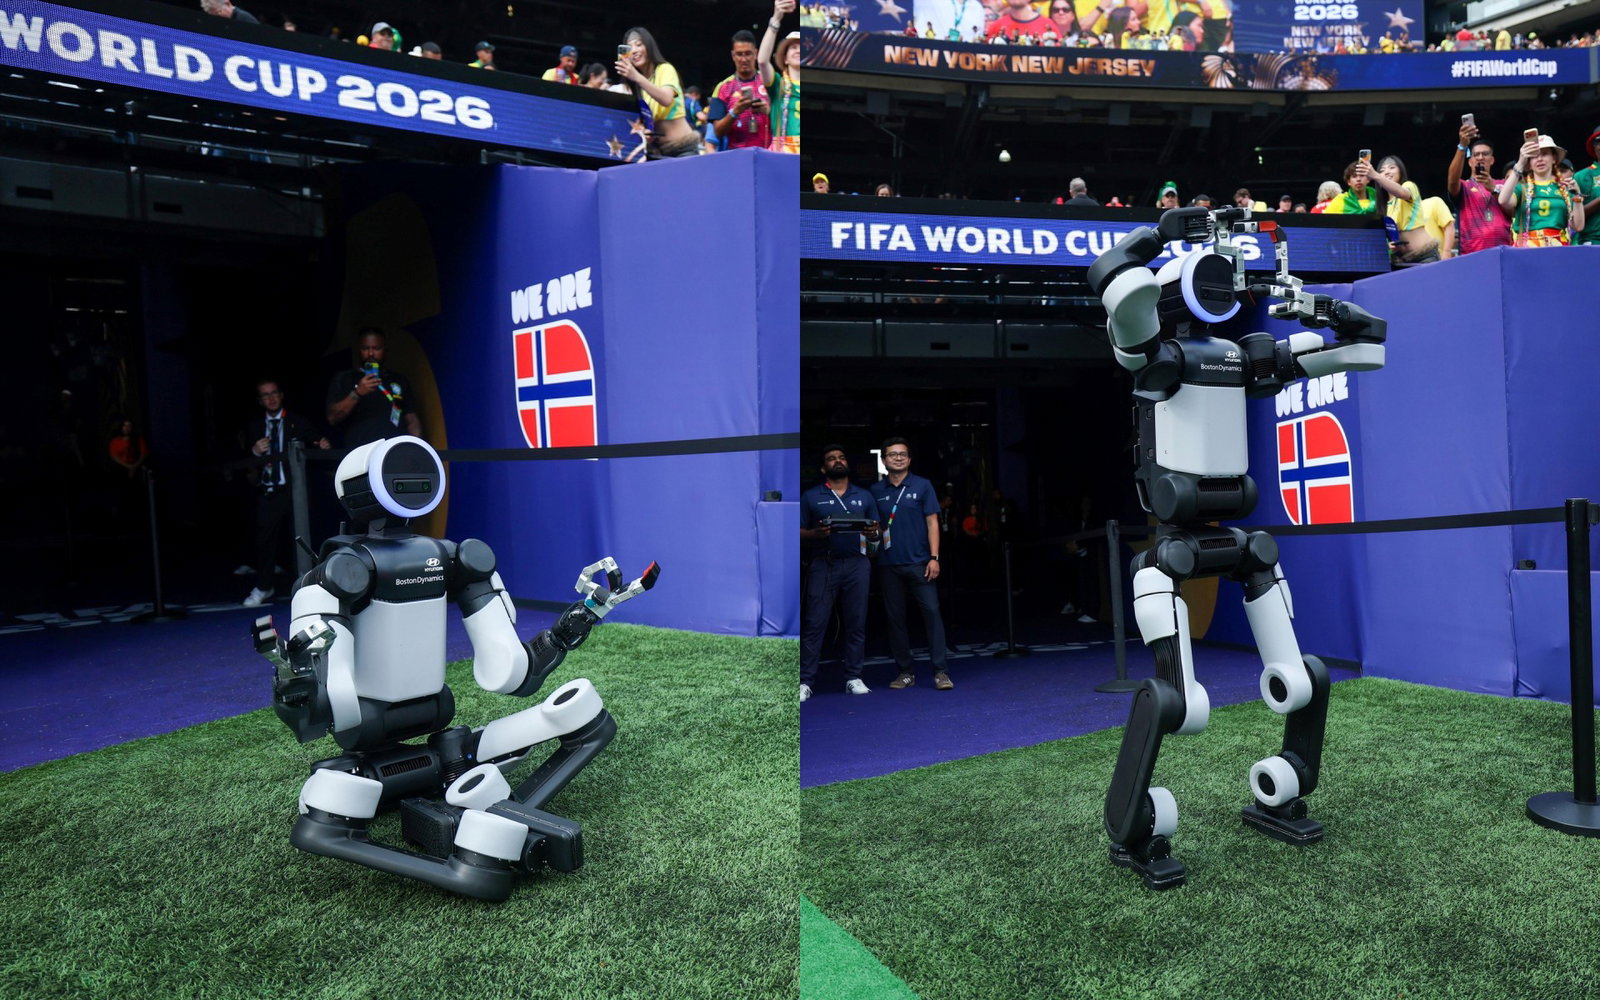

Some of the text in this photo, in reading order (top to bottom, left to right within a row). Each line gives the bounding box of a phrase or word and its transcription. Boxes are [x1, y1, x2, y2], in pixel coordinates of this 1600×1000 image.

[1294, 4, 1359, 20] 2026
[1283, 37, 1314, 48] NEW
[1291, 25, 1362, 36] NEW YORK
[0, 9, 493, 130] WORLD CUP 2026
[884, 45, 1155, 77] NEW YORK NEW JERSEY
[1451, 58, 1557, 78] #FIFAWorldCup
[1538, 199, 1551, 216] 9
[831, 222, 916, 251] FIFA
[921, 226, 1058, 255] WORLD
[511, 267, 592, 324] WE ARE
[1275, 371, 1348, 418] WE ARE
